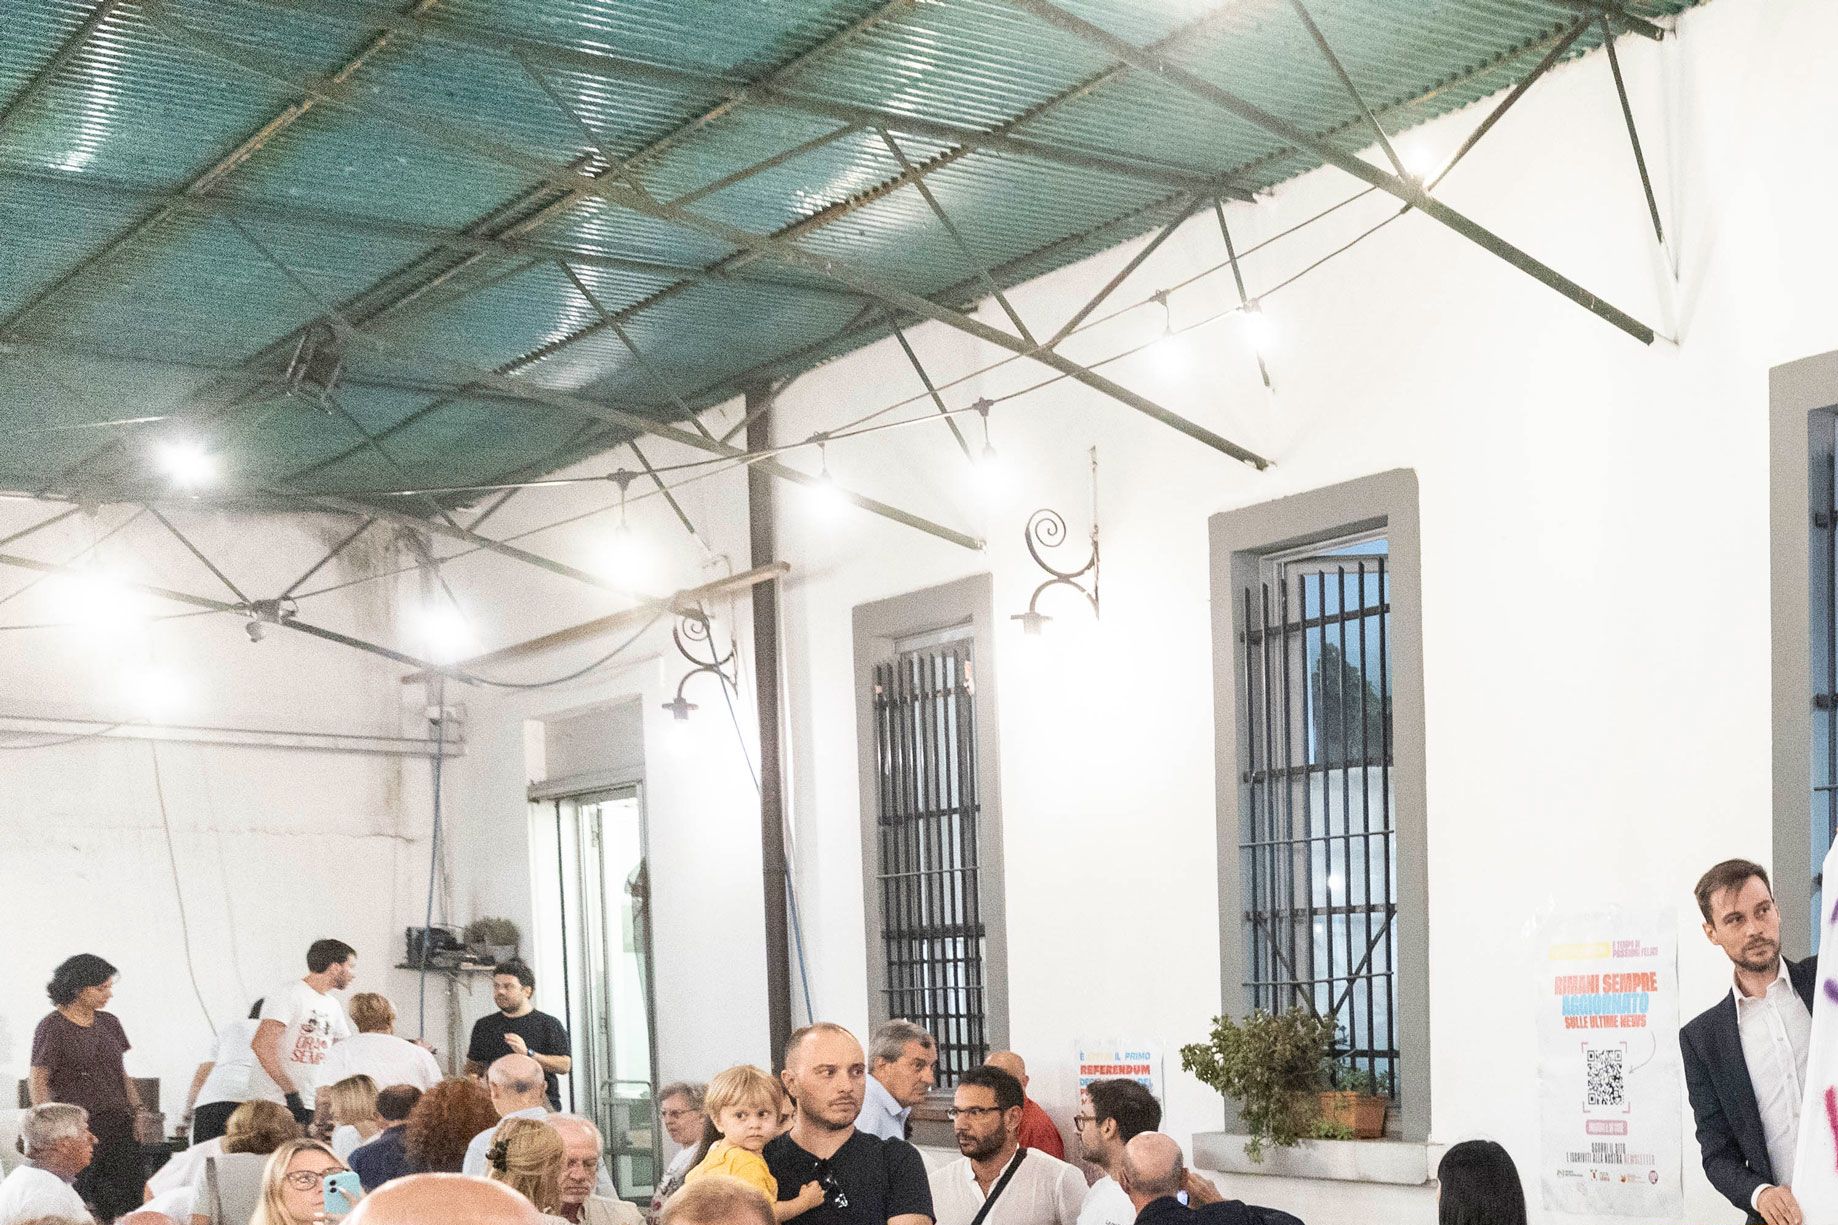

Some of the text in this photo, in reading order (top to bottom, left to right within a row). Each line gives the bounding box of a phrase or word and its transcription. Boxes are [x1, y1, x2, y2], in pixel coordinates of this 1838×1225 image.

[1602, 972, 1658, 993] SEMPRE
[1562, 992, 1649, 1016] AGGIORNATO
[1564, 1016, 1588, 1029] SULLE
[1589, 1015, 1619, 1028] ULTIME
[1124, 1051, 1151, 1061] PRIMO
[1080, 1064, 1151, 1075] REFERENDUM
